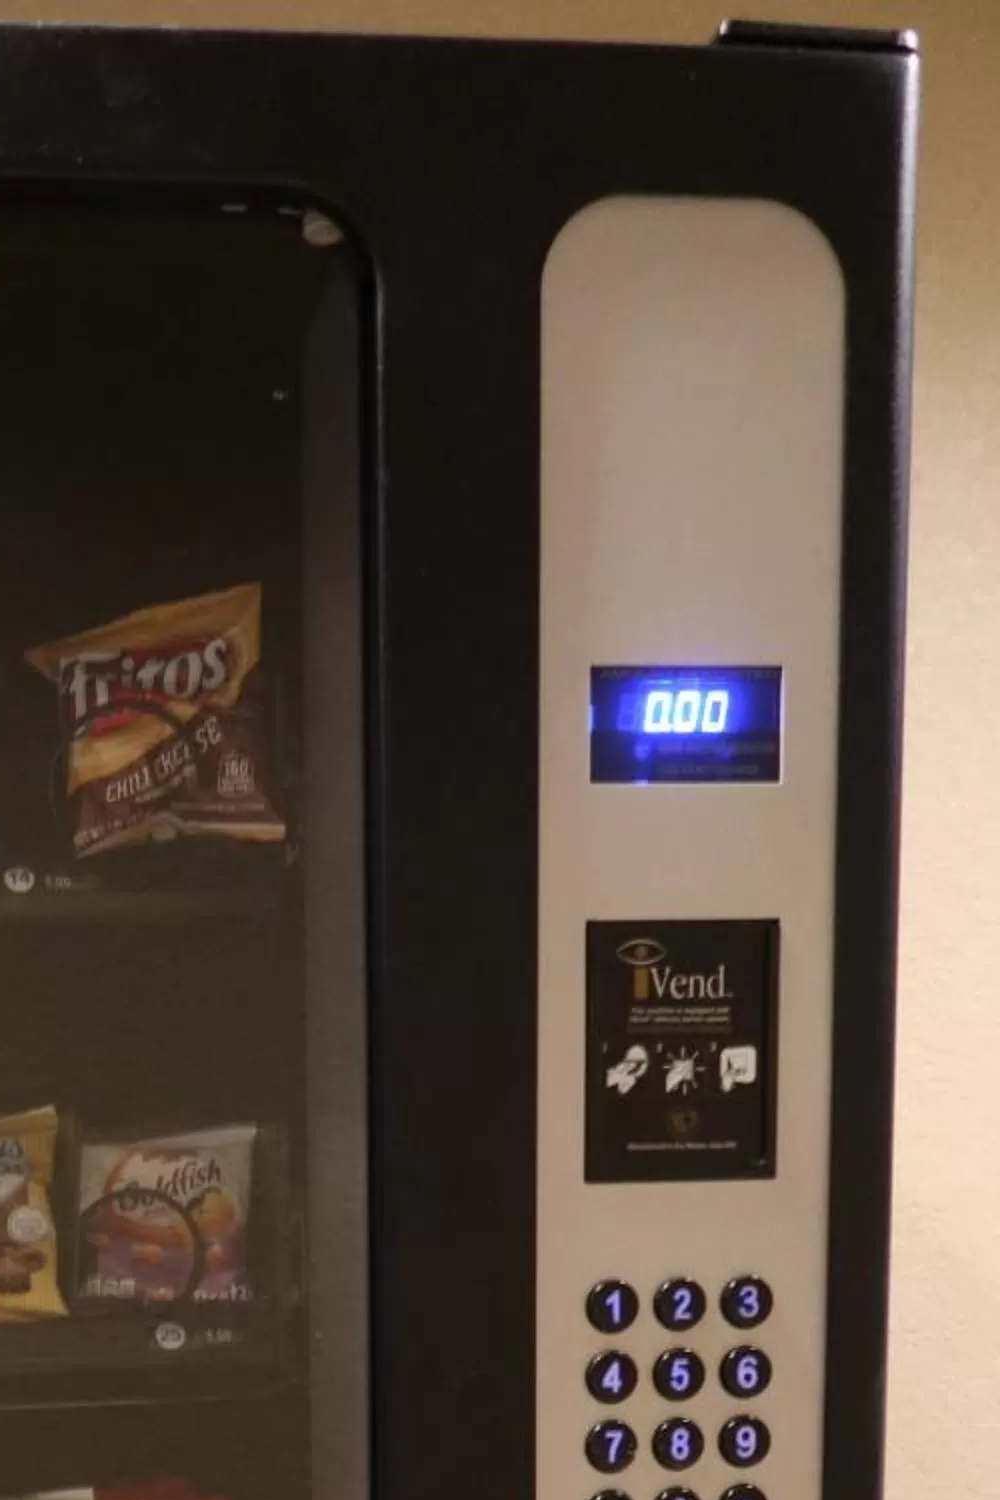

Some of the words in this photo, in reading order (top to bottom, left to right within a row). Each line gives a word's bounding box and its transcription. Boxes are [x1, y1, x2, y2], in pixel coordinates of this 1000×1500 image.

[59, 639, 229, 721] Fritos
[605, 1290, 621, 1325] 1
[673, 1287, 693, 1321] 2
[739, 1285, 760, 1319] 3
[601, 1360, 622, 1394] 4
[669, 1358, 690, 1392] 5
[736, 1355, 759, 1390] 6
[604, 1429, 624, 1464] 7
[670, 1427, 690, 1461] 8
[735, 1424, 758, 1459] 9
